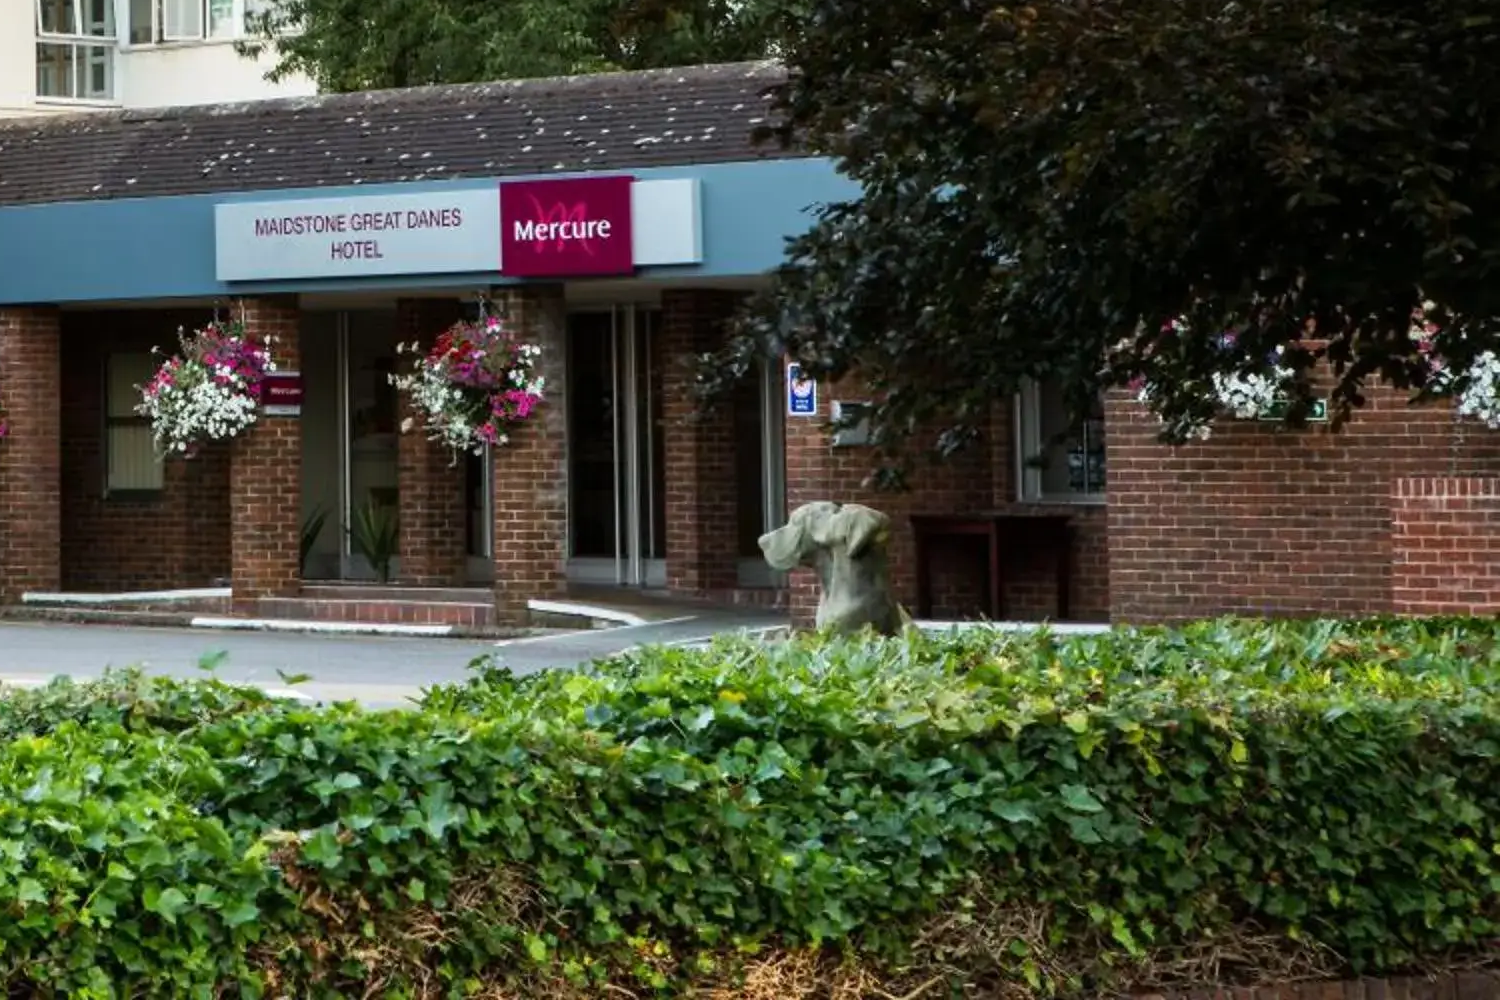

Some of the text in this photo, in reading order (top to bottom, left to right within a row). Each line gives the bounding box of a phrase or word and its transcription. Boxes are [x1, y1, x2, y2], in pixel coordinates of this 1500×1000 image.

[255, 208, 462, 237] MAIDSTONE GREAT DANES
[514, 218, 612, 242] Mercure
[331, 240, 384, 260] HOTEL
